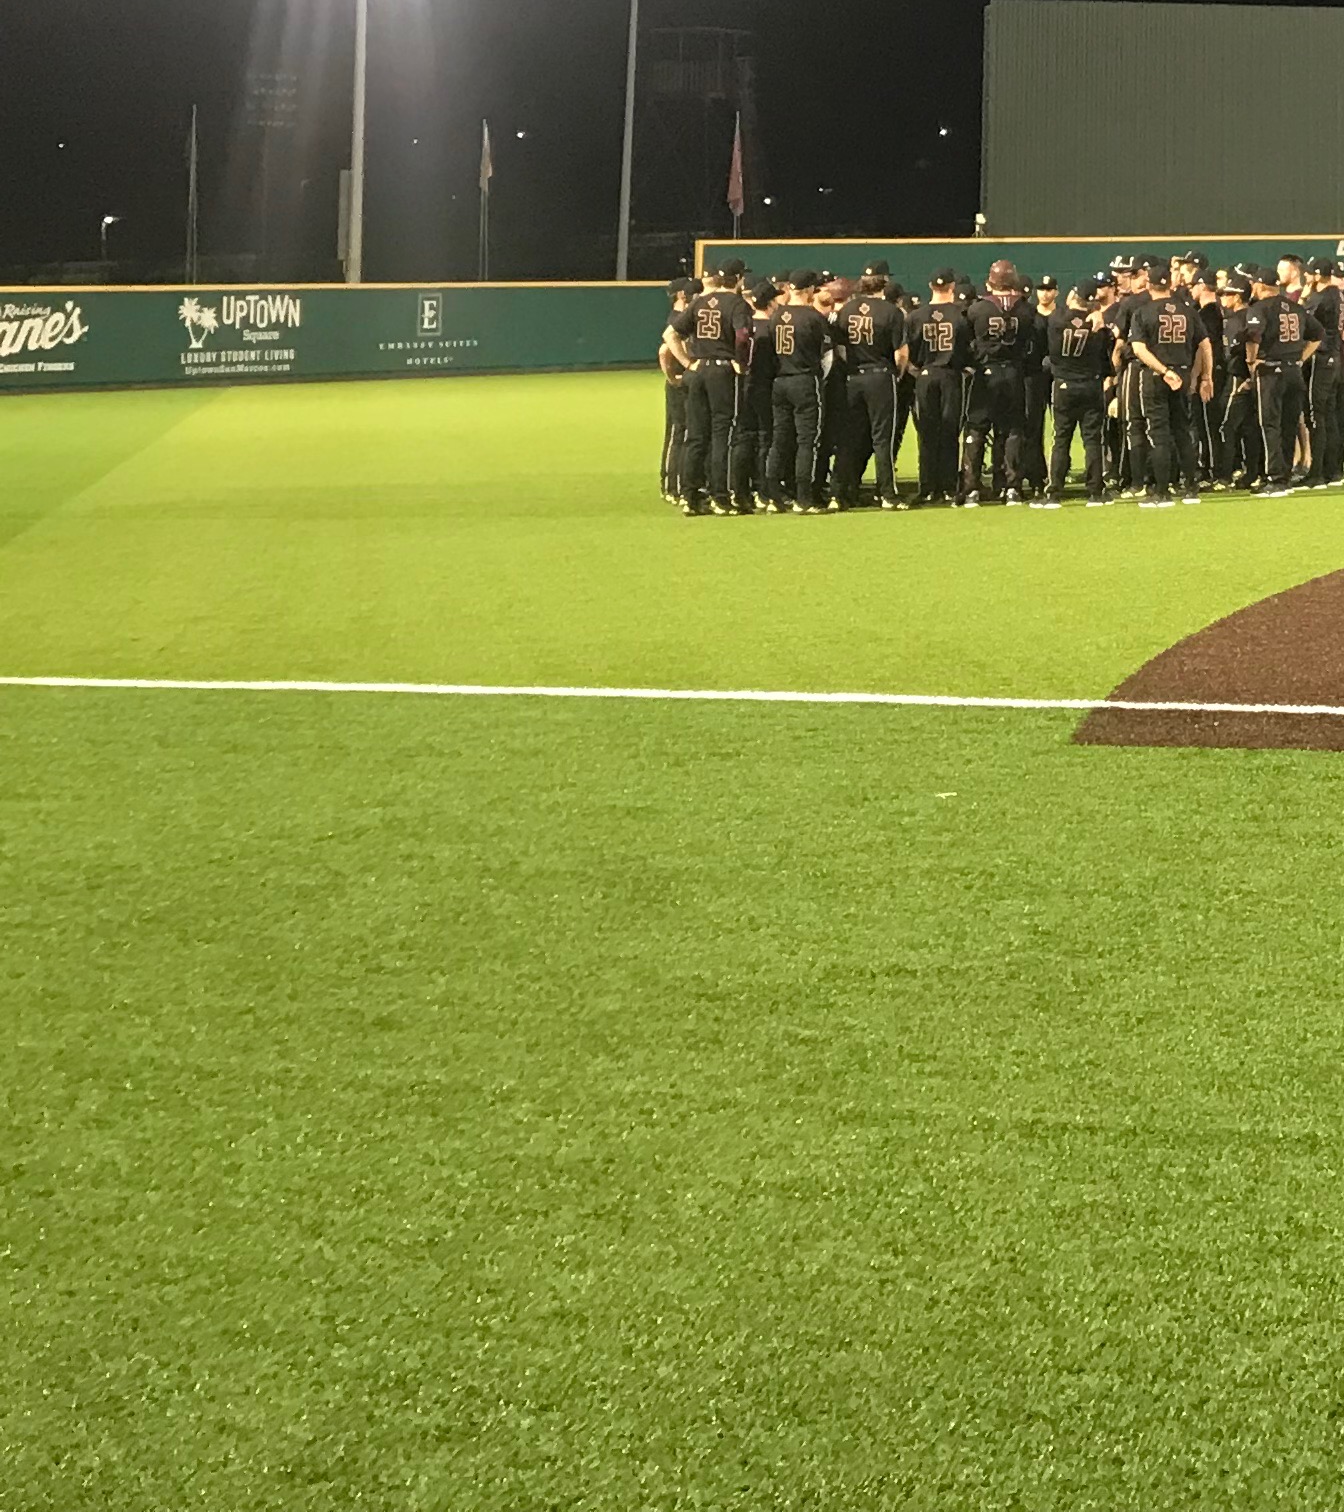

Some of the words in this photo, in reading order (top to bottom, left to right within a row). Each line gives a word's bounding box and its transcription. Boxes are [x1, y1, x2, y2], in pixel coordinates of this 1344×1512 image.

[3, 303, 51, 320] Raising
[222, 294, 300, 329] UPTOWN
[697, 308, 721, 339] 25
[242, 329, 280, 344] Square
[775, 324, 795, 355] 15
[848, 314, 874, 345] 34
[923, 322, 953, 352] 42
[1158, 314, 1187, 344] 22
[1279, 313, 1300, 342] 33
[180, 352, 217, 365] LUXURY
[220, 350, 261, 363] STUDENT
[264, 349, 295, 361] LIVING
[379, 341, 434, 350] EMBASSY
[439, 339, 478, 348] SUITES
[1061, 328, 1089, 357] 17
